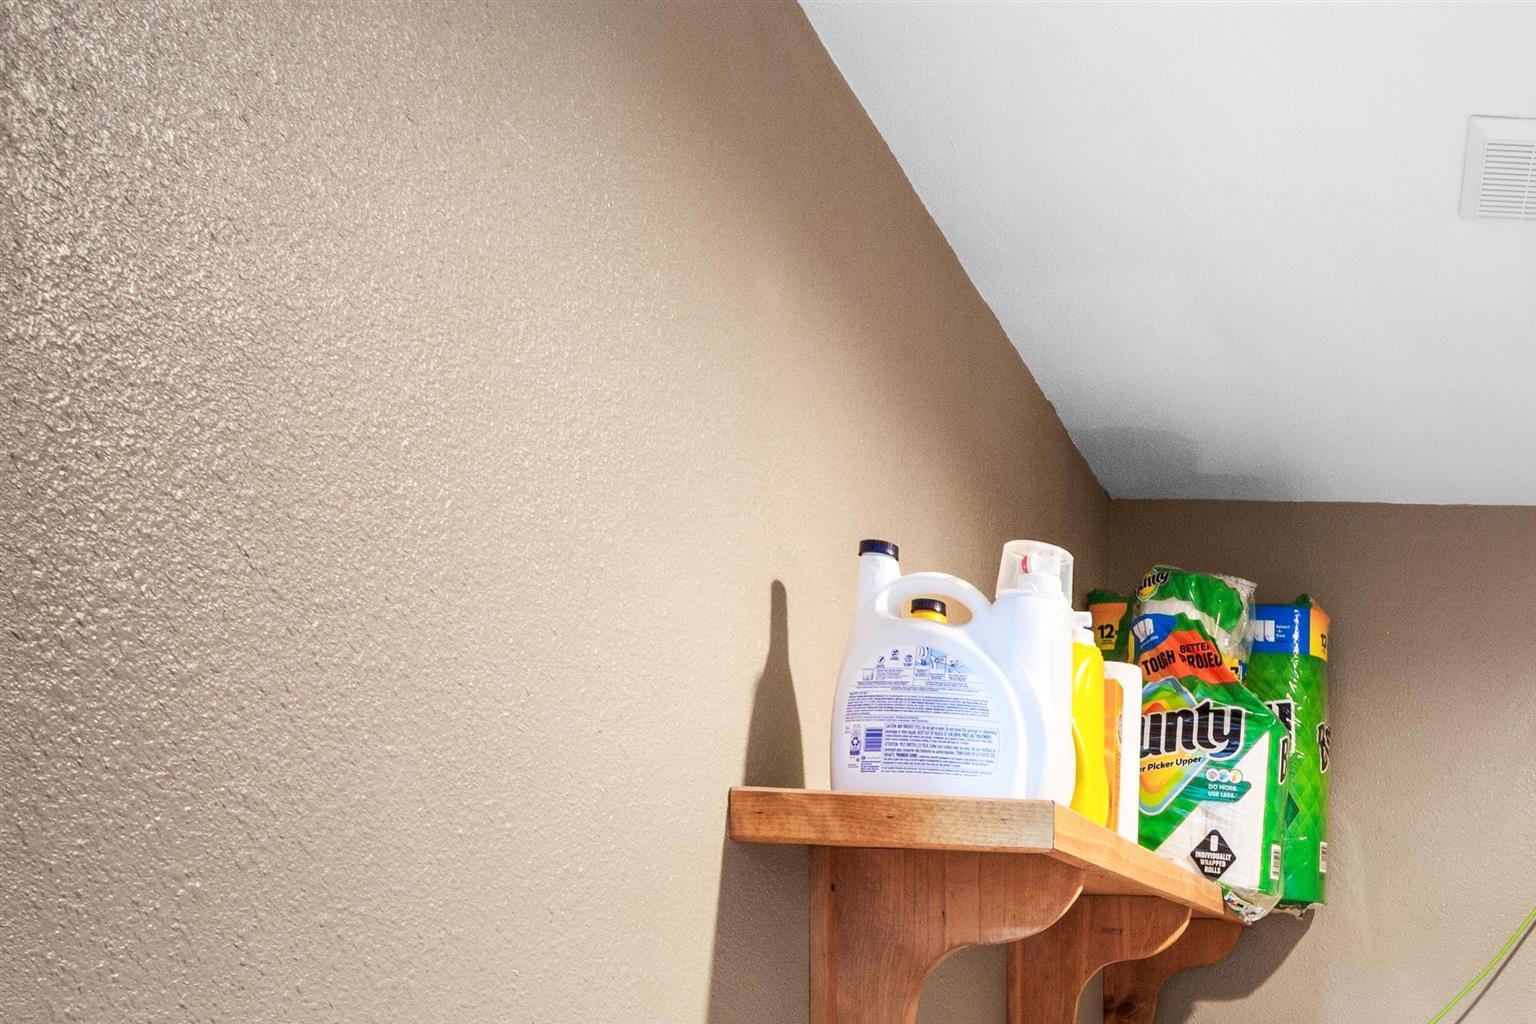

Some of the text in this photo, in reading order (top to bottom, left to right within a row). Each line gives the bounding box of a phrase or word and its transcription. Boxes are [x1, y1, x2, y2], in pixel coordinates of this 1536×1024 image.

[1147, 761, 1174, 771] Picker
[1176, 756, 1202, 768] Upper
[1195, 850, 1232, 862] INDIVIDUALLY
[1200, 858, 1227, 868] WRAPPED
[1204, 866, 1222, 875] ROLLS
